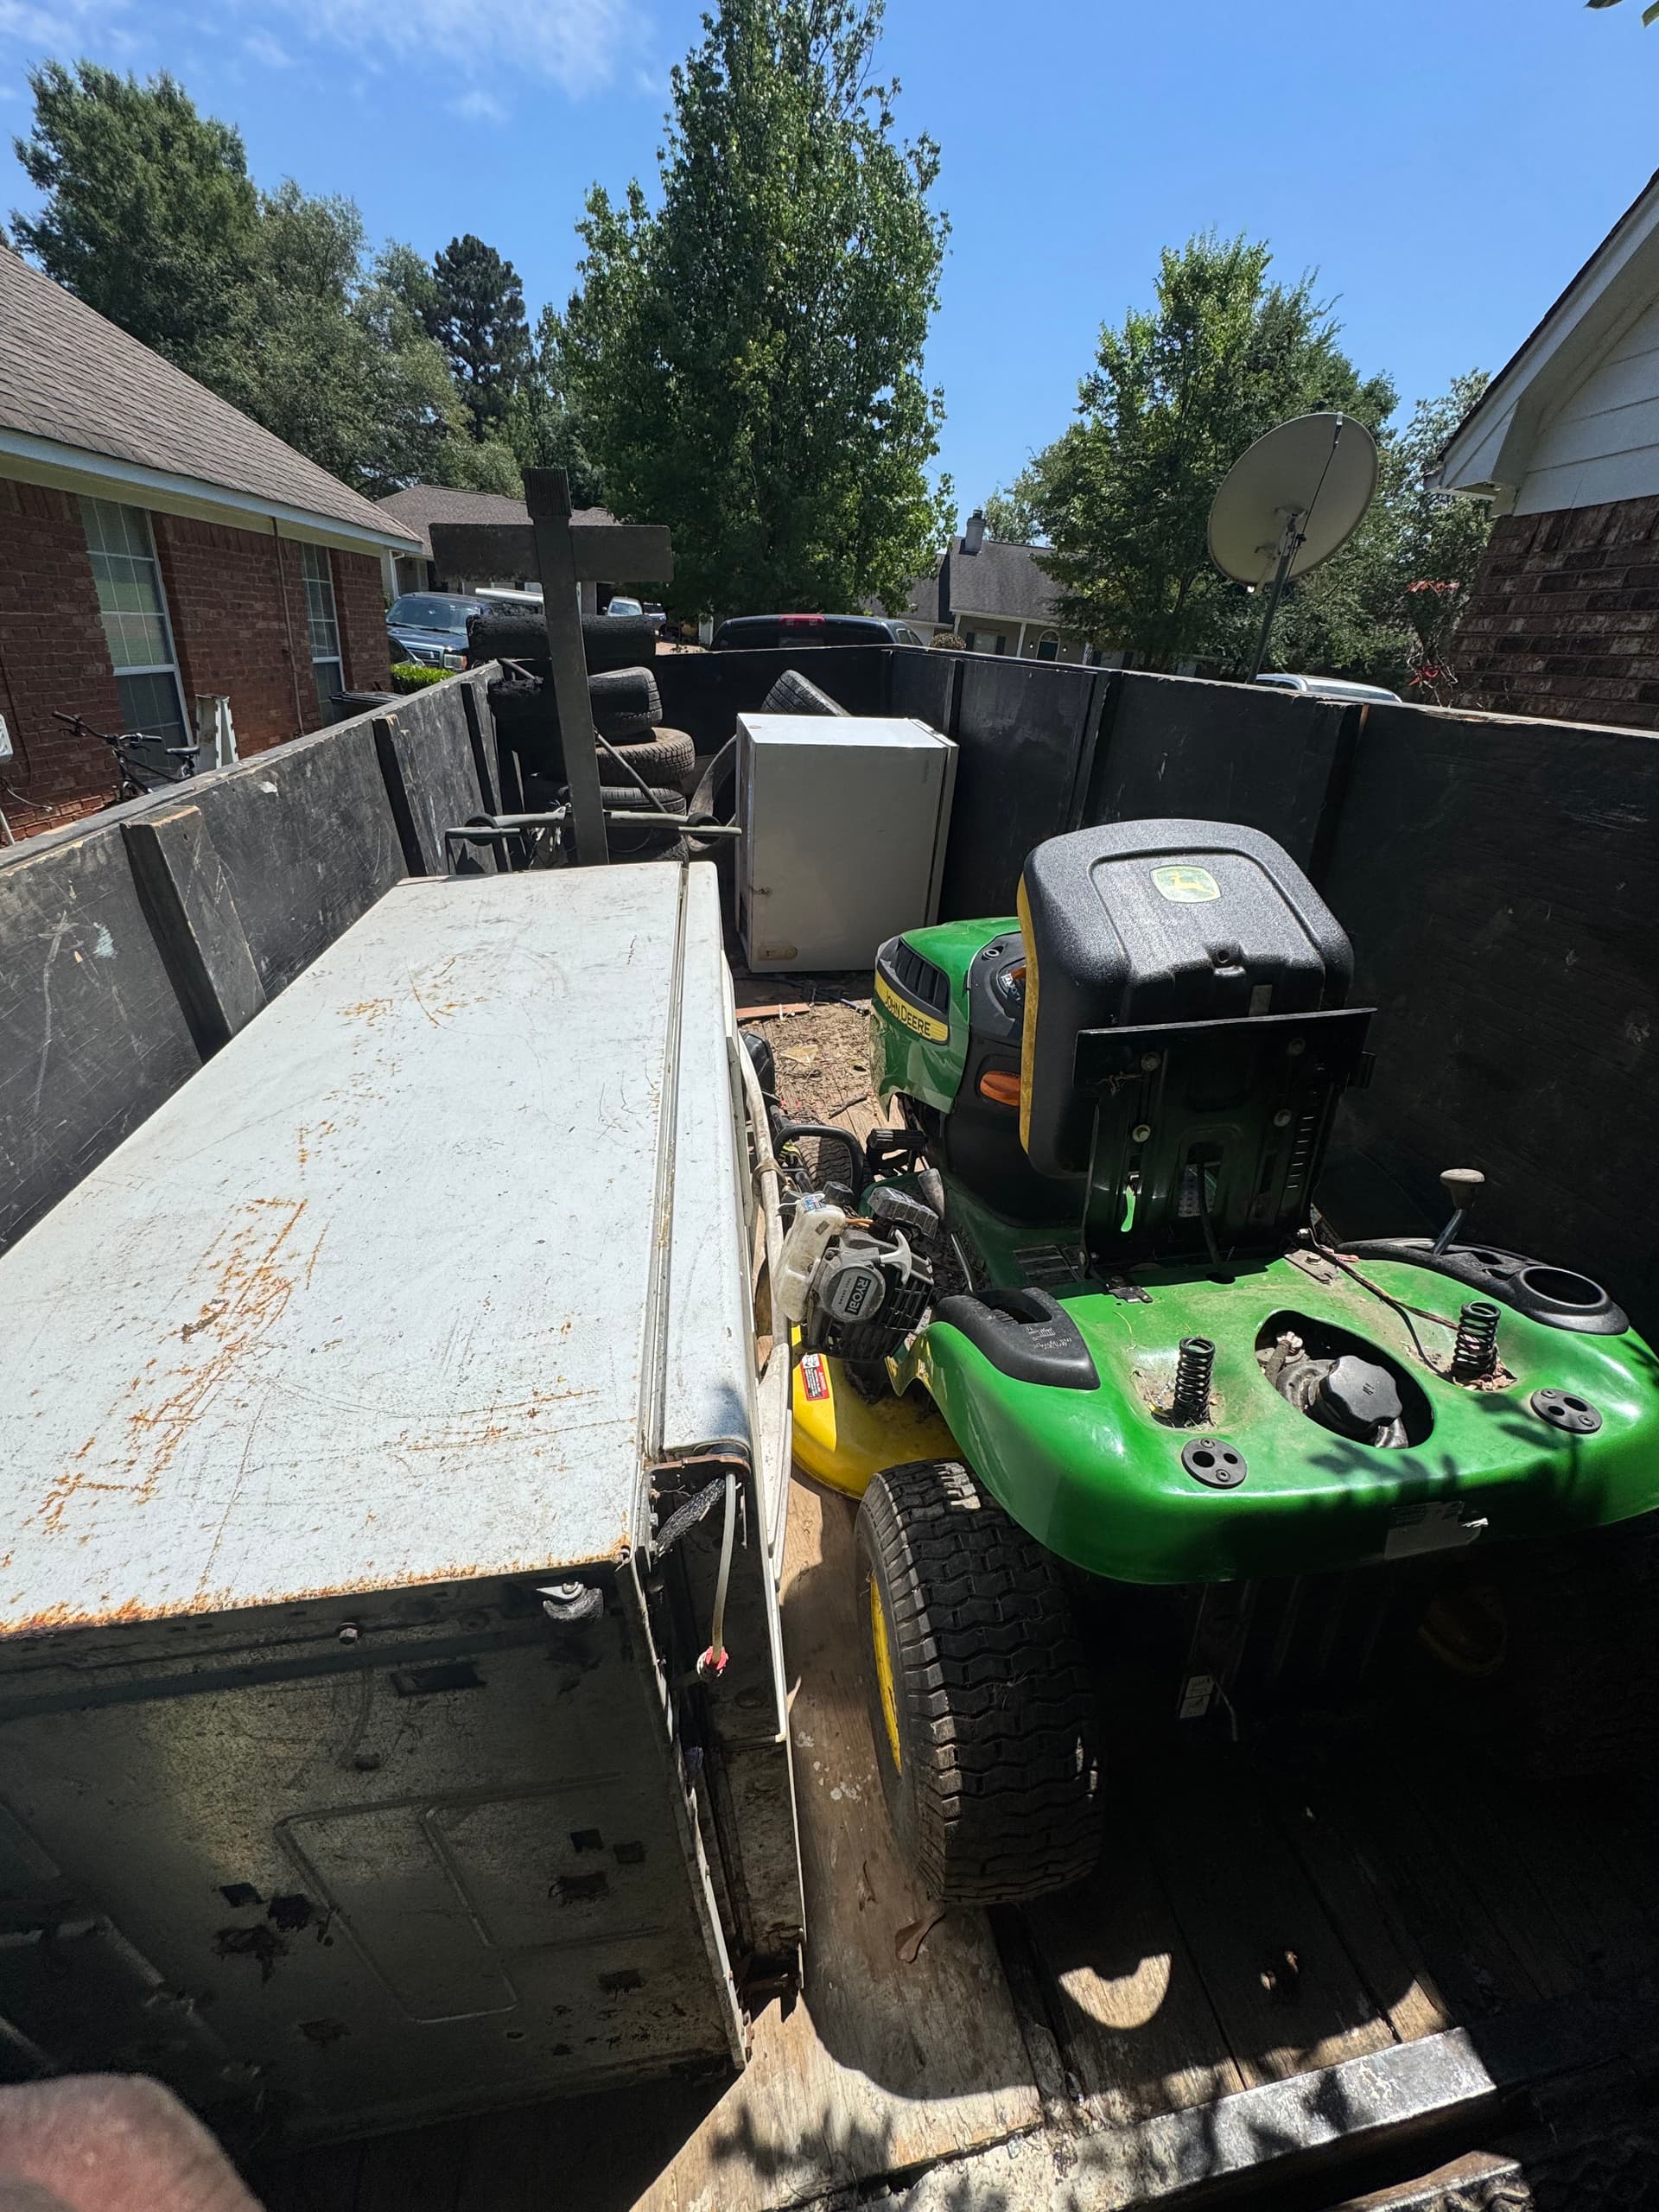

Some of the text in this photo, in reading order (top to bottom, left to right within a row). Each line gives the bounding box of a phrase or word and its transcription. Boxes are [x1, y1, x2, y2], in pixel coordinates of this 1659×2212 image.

[885, 989, 931, 1037] JOHN DEERE
[848, 1279, 868, 1313] RYOBI
